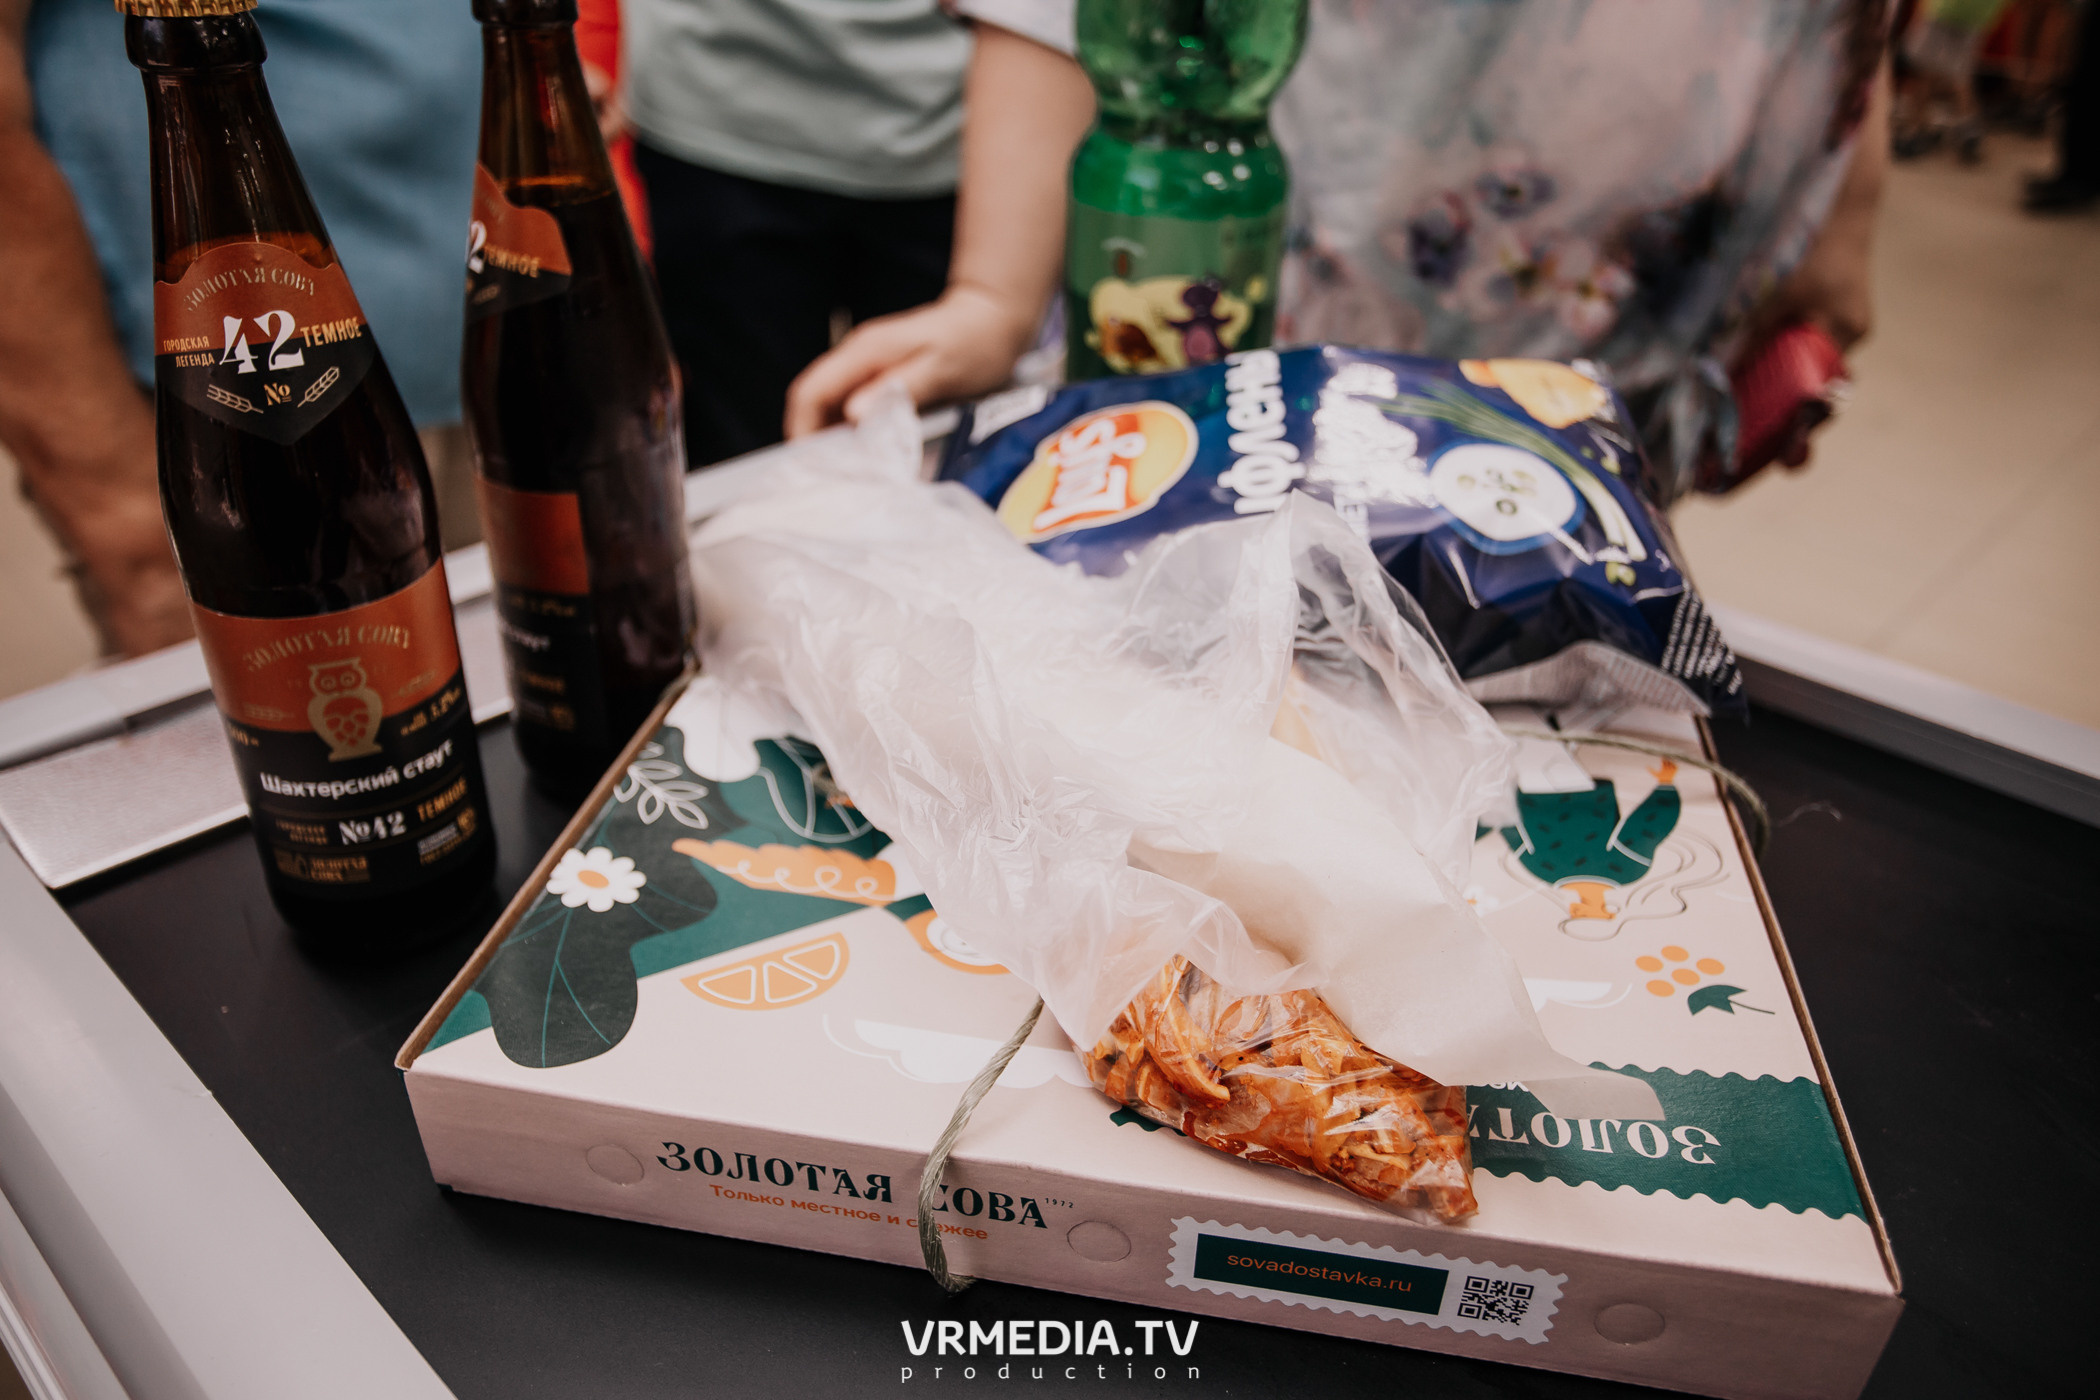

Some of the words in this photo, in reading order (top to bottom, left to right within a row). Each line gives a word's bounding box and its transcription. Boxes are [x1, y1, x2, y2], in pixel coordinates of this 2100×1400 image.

[466, 219, 487, 274] 2
[183, 267, 267, 312] ЗОЛОТАЯ
[271, 267, 315, 296] СОВА
[163, 335, 210, 352] ГОРОДСКАЯ
[175, 352, 215, 368] ЛЕГЕНДА
[219, 310, 305, 374] 42
[300, 316, 362, 348] ТЕМНОЕ
[259, 764, 400, 800] Шахтерский
[402, 739, 454, 780] стаут
[656, 1142, 893, 1204] ЗОЛОТАЯ
[1044, 1196, 1075, 1209] 1972
[709, 1184, 785, 1207] Только
[790, 1201, 881, 1222] местное
[887, 1215, 901, 1225] и
[906, 1217, 989, 1240] сжее
[1227, 1252, 1412, 1293] sovadostavka.ru
